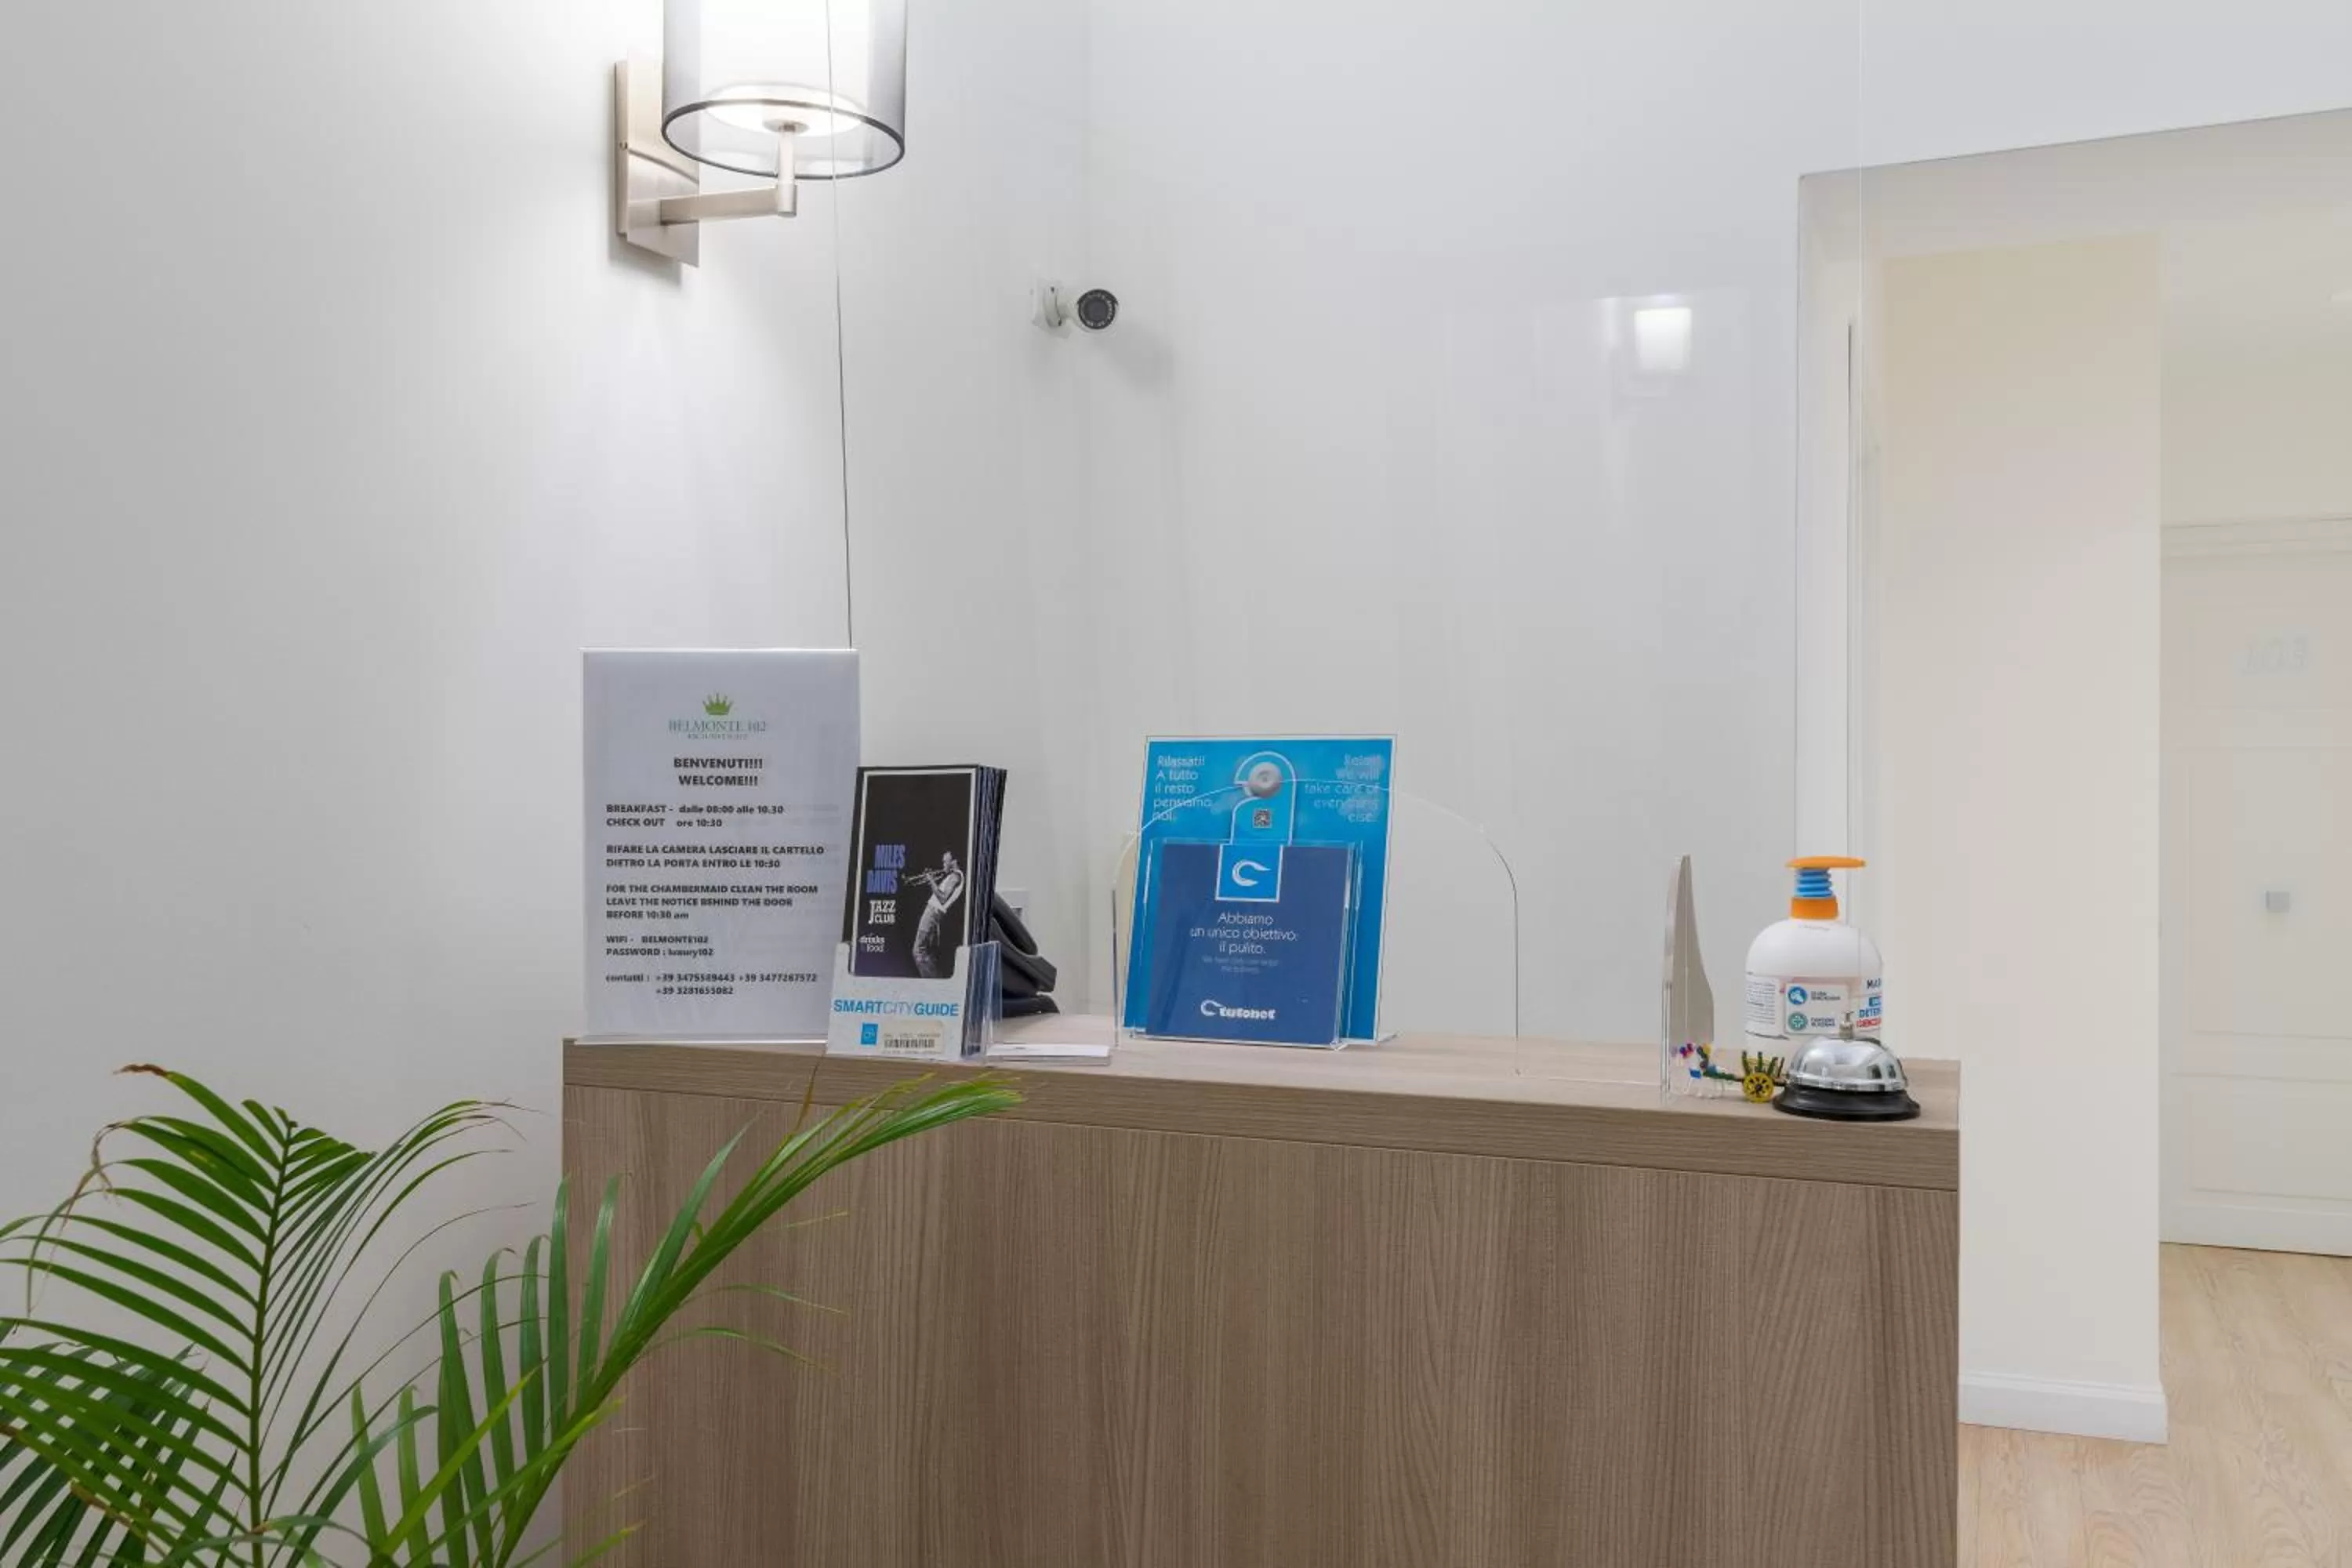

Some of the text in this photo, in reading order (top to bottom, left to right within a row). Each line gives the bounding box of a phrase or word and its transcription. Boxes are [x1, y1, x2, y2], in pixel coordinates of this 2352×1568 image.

[669, 720, 743, 732] BELMONTE
[673, 757, 763, 769] BENVENUTI!!!
[678, 775, 758, 786] WELCOME!!!
[1156, 769, 1199, 781] A tutto
[1165, 784, 1195, 794] resto
[1304, 783, 1330, 794] take
[606, 804, 666, 814] BREAKFAST
[679, 804, 703, 814] dalle
[706, 805, 734, 814] 08:00
[736, 805, 755, 814] alle
[606, 818, 641, 827] CHECK
[644, 818, 665, 827] OUT
[696, 819, 723, 828] 10:30
[606, 845, 825, 855] RIFARE LA CAMERA LASCIARE IL CARTELLO
[874, 844, 906, 869] MILES
[606, 859, 644, 868] DIETRO
[648, 859, 661, 868] LA
[664, 859, 699, 868] PORTA
[702, 859, 737, 868] ENTRO
[740, 859, 751, 868] LE
[866, 869, 898, 895] DAVIS
[606, 884, 818, 894] FOR THE CHAMBERMAID CLEAN THE ROOM
[606, 897, 793, 906] LEAVE THE NOTICE BEHIND THE DOOR
[606, 910, 644, 919] BEFORE
[868, 899, 896, 924] JAZZ
[874, 913, 895, 924] CLUB
[1218, 912, 1274, 925] Abbiamo
[1190, 927, 1205, 938] un
[1207, 927, 1240, 939] unico
[1219, 941, 1266, 955] il pulito.
[655, 973, 673, 982] +39
[655, 986, 674, 995] +39
